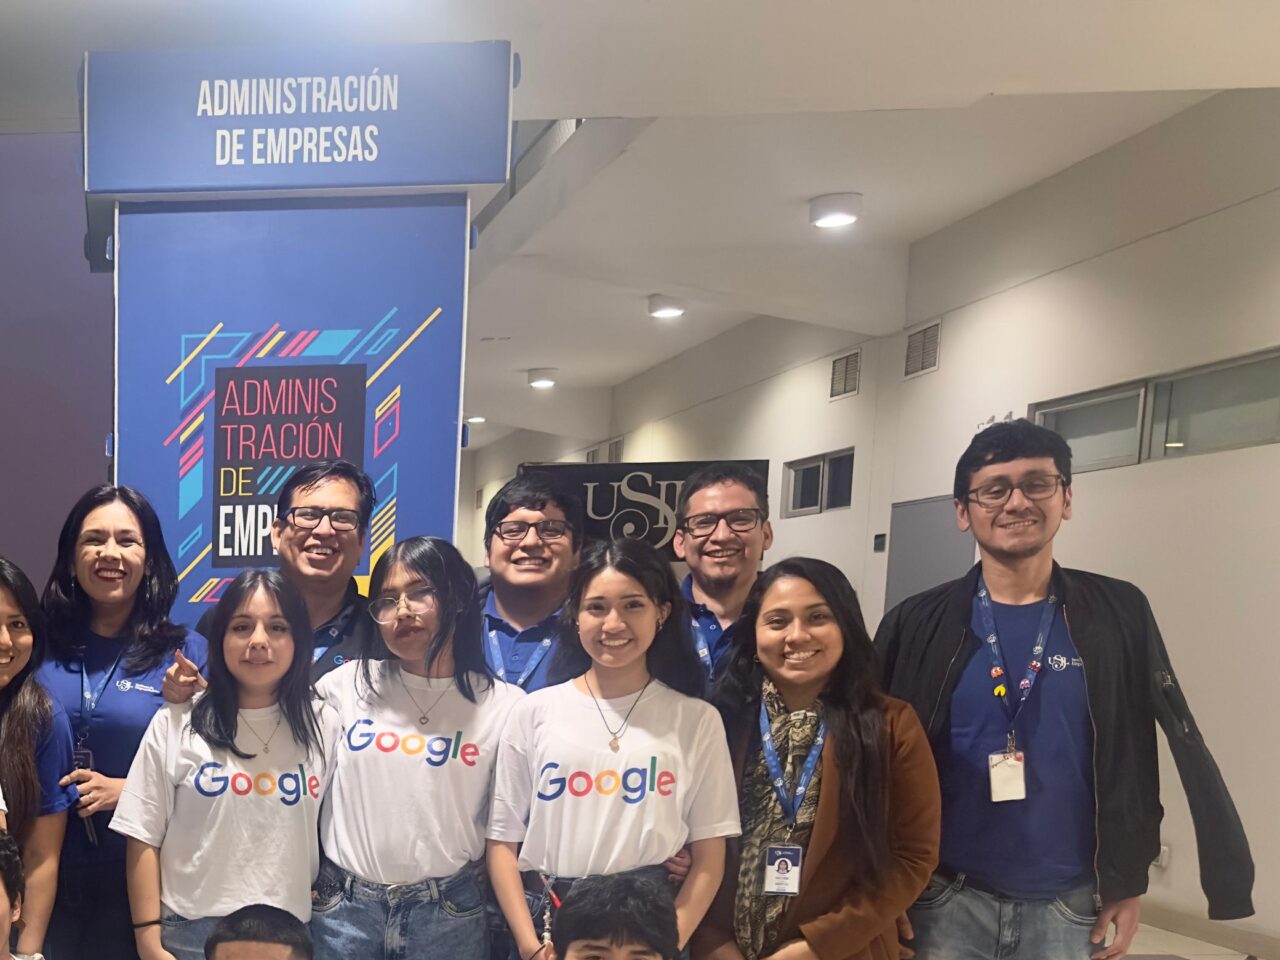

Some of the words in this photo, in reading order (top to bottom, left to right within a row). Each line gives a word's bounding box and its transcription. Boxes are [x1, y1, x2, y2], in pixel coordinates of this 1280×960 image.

[196, 67, 399, 117] ADMINISTRACIÓN
[215, 128, 246, 166] DE
[252, 124, 379, 166] EMPRESAS
[221, 377, 338, 416] ADMINIS
[220, 415, 343, 461] TRACIÓN
[220, 466, 254, 497] DE
[347, 718, 480, 767] Google
[193, 761, 321, 807] Google
[536, 755, 677, 805] Google
